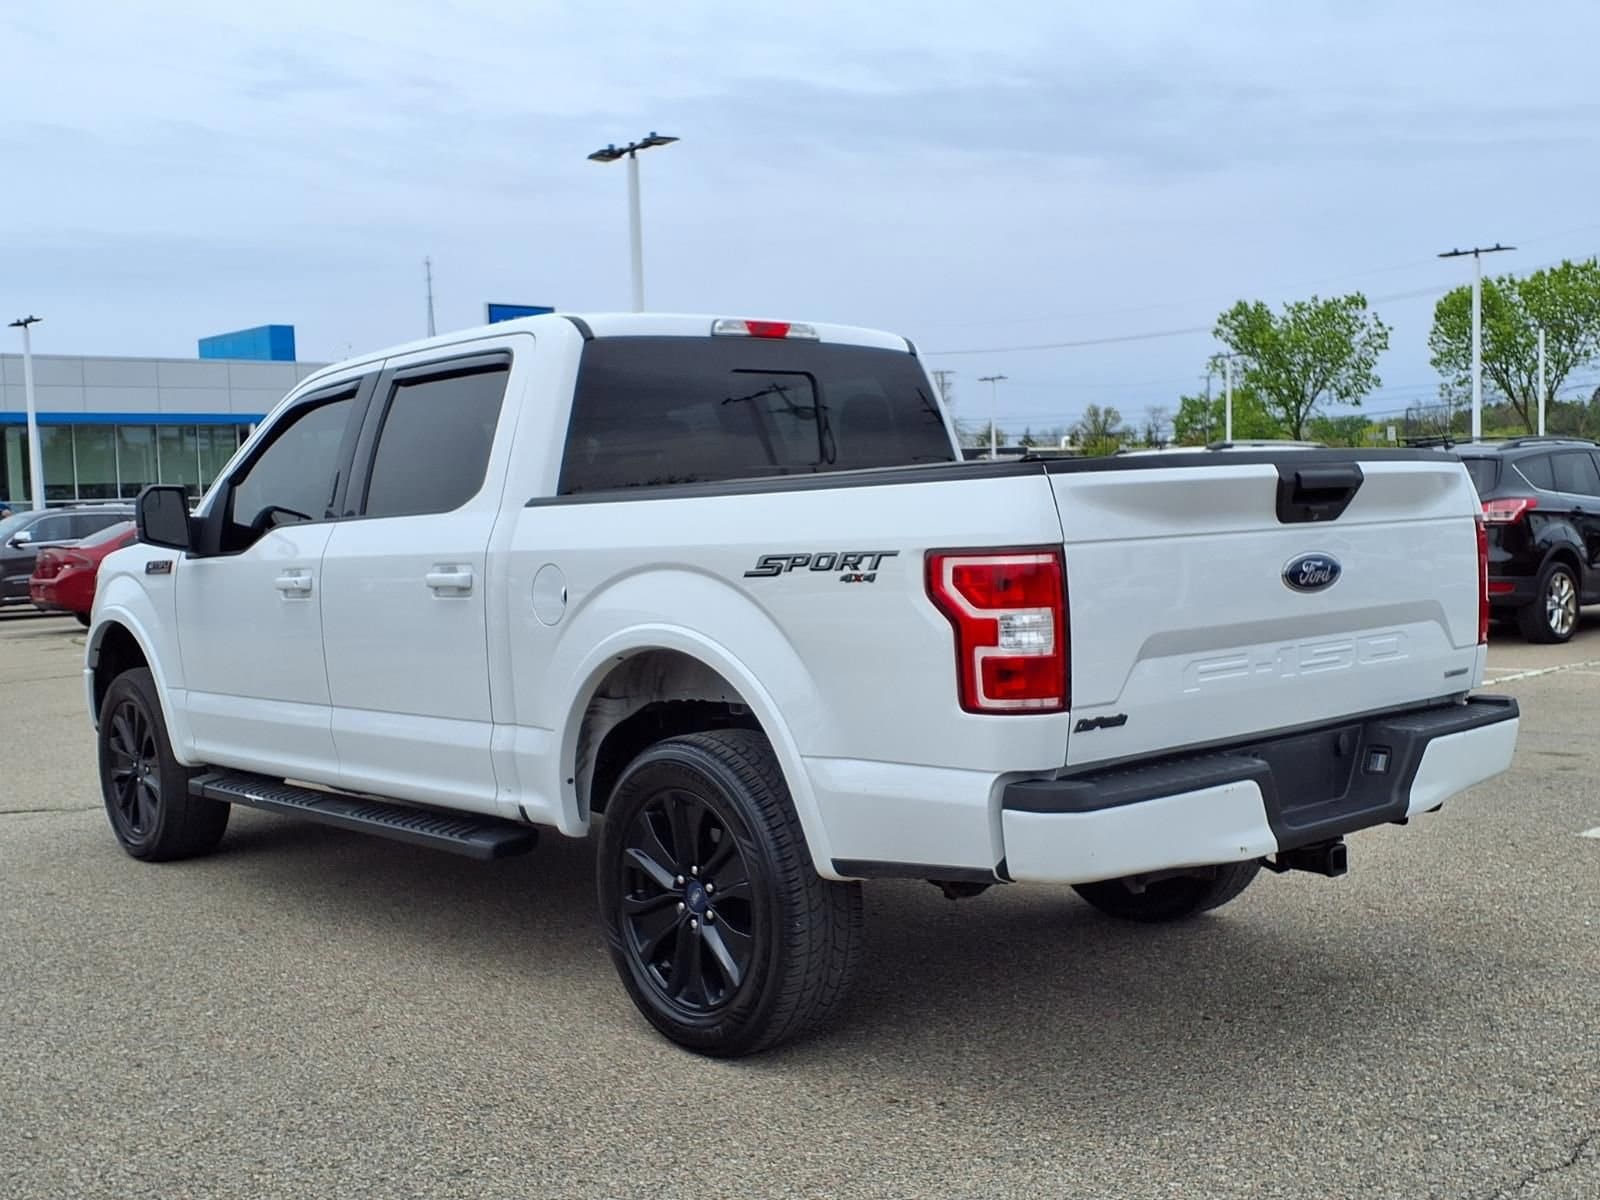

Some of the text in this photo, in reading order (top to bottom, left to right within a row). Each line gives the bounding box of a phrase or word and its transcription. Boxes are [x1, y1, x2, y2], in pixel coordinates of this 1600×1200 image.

[743, 550, 900, 578] SPORT
[1298, 559, 1333, 585] Ford
[1182, 630, 1410, 694] F-150
